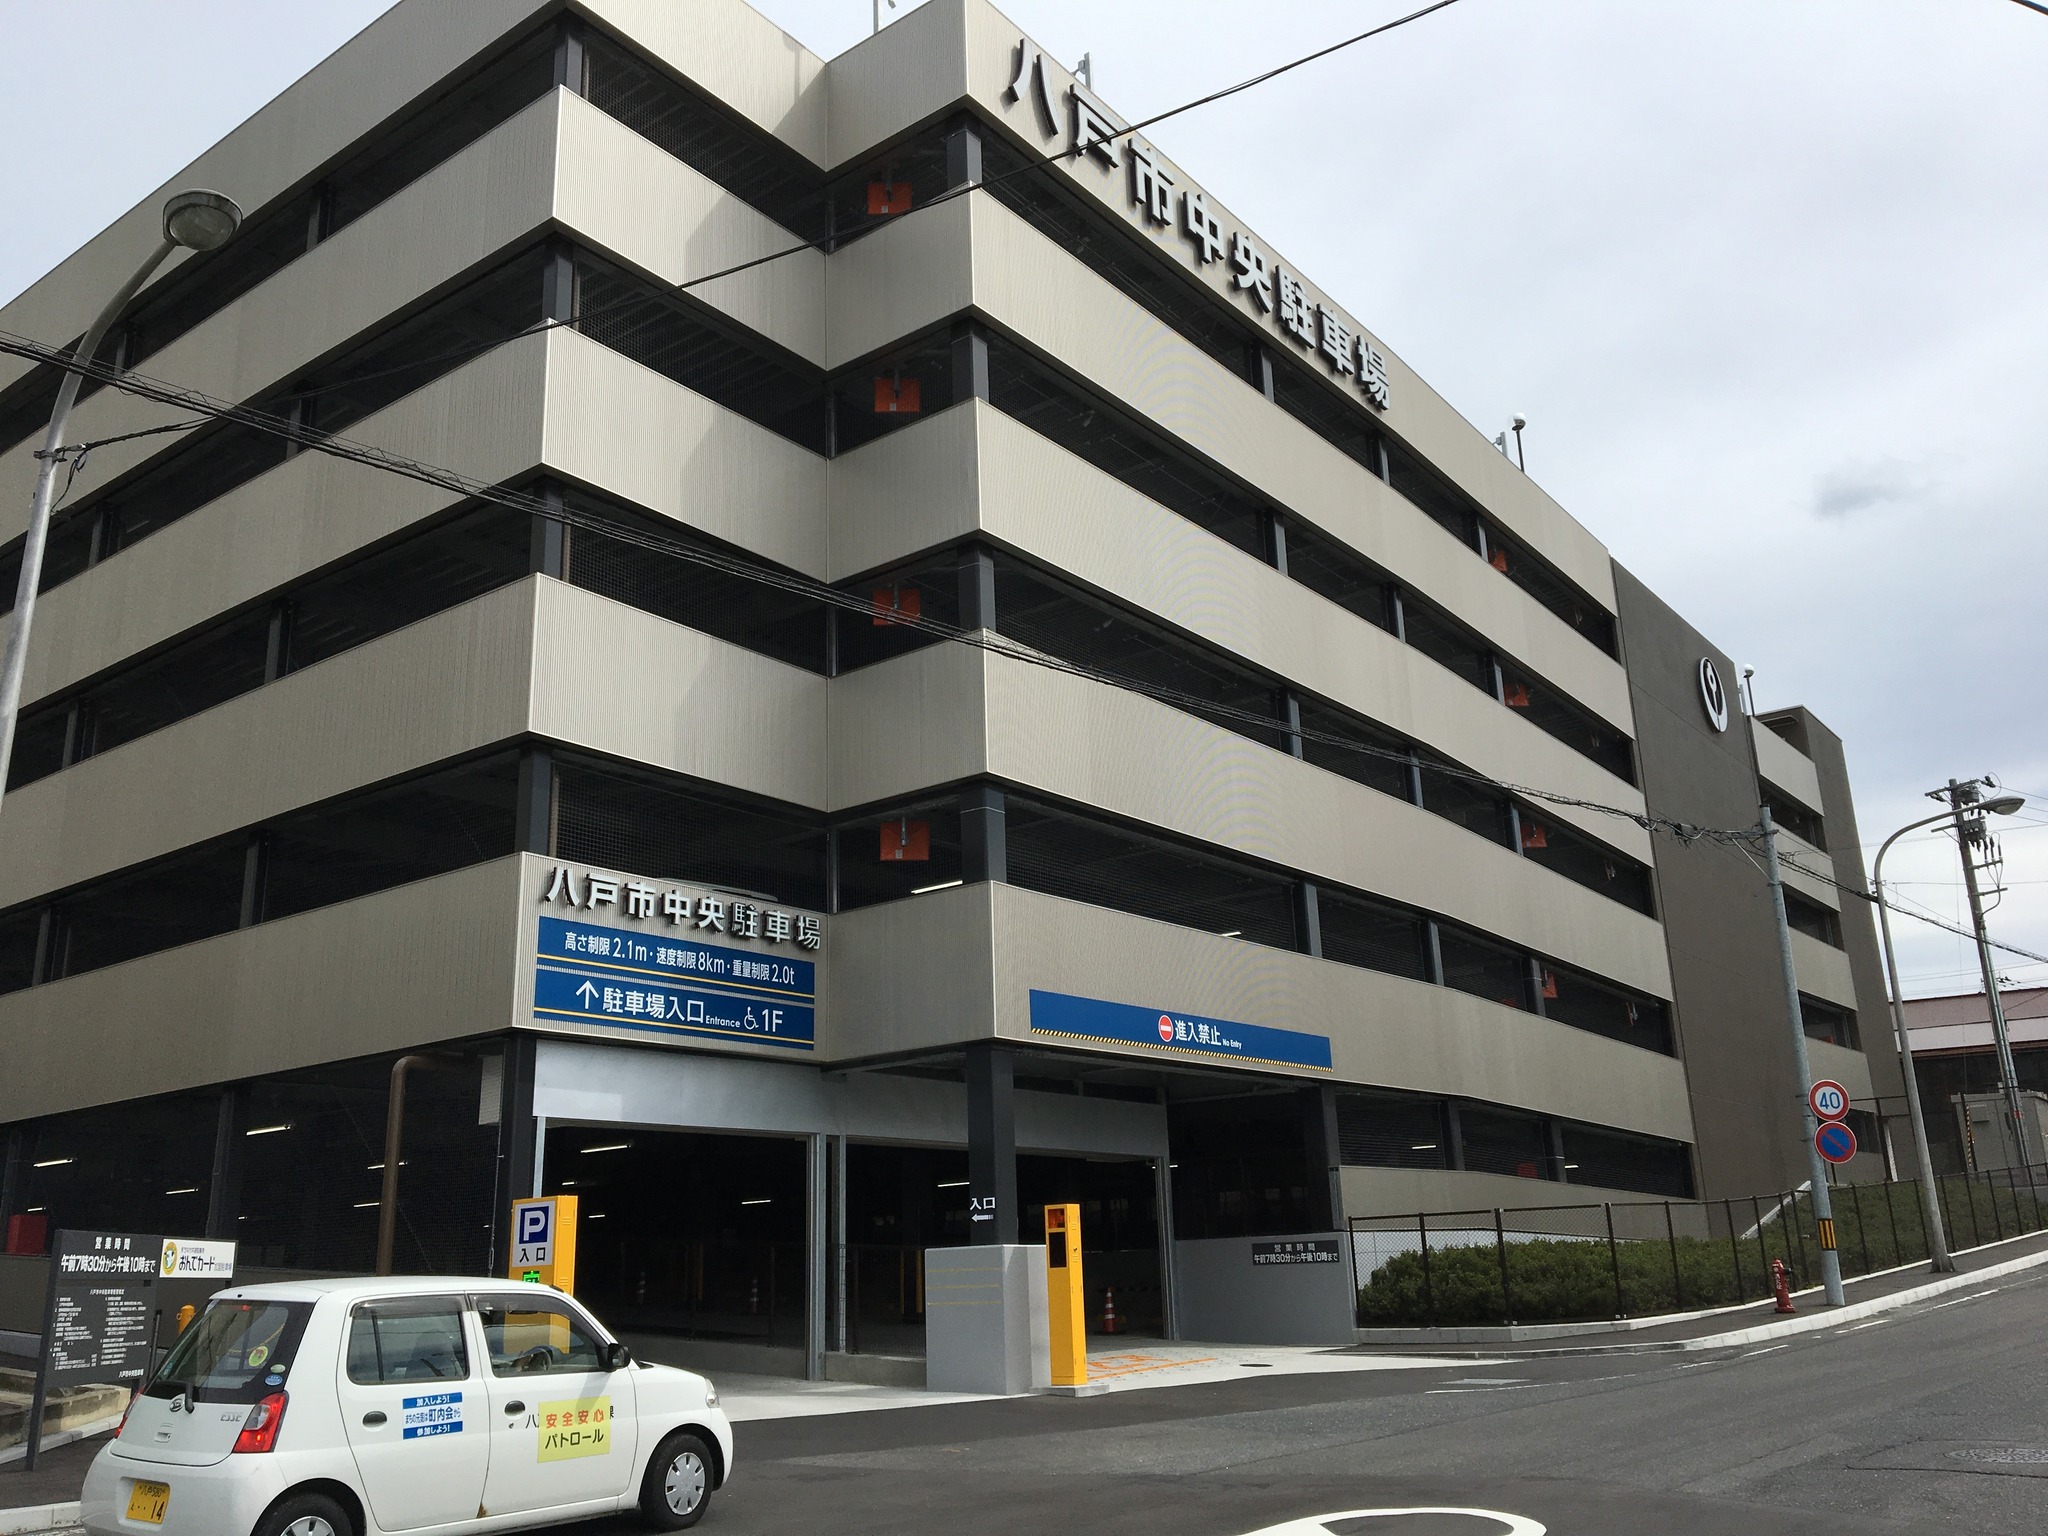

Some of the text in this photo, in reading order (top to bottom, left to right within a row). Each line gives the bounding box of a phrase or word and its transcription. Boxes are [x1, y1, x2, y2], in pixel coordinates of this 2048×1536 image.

[1007, 37, 1390, 411] 八戸市中央駐車場
[544, 866, 821, 950] 八戸市中央駐車場
[602, 987, 783, 1032] 駐車場入口 Entrance 1F
[1175, 1019, 1242, 1050] 進入禁止 No Entry
[1819, 1092, 1841, 1110] 40
[969, 1197, 996, 1210] 入口
[523, 1210, 546, 1242] P
[95, 1236, 131, 1250] 営業時間
[1274, 1243, 1316, 1252] 営業時間
[519, 1247, 546, 1263] 入口
[545, 1408, 605, 1429] 安全安心
[545, 1428, 604, 1449] パトロール
